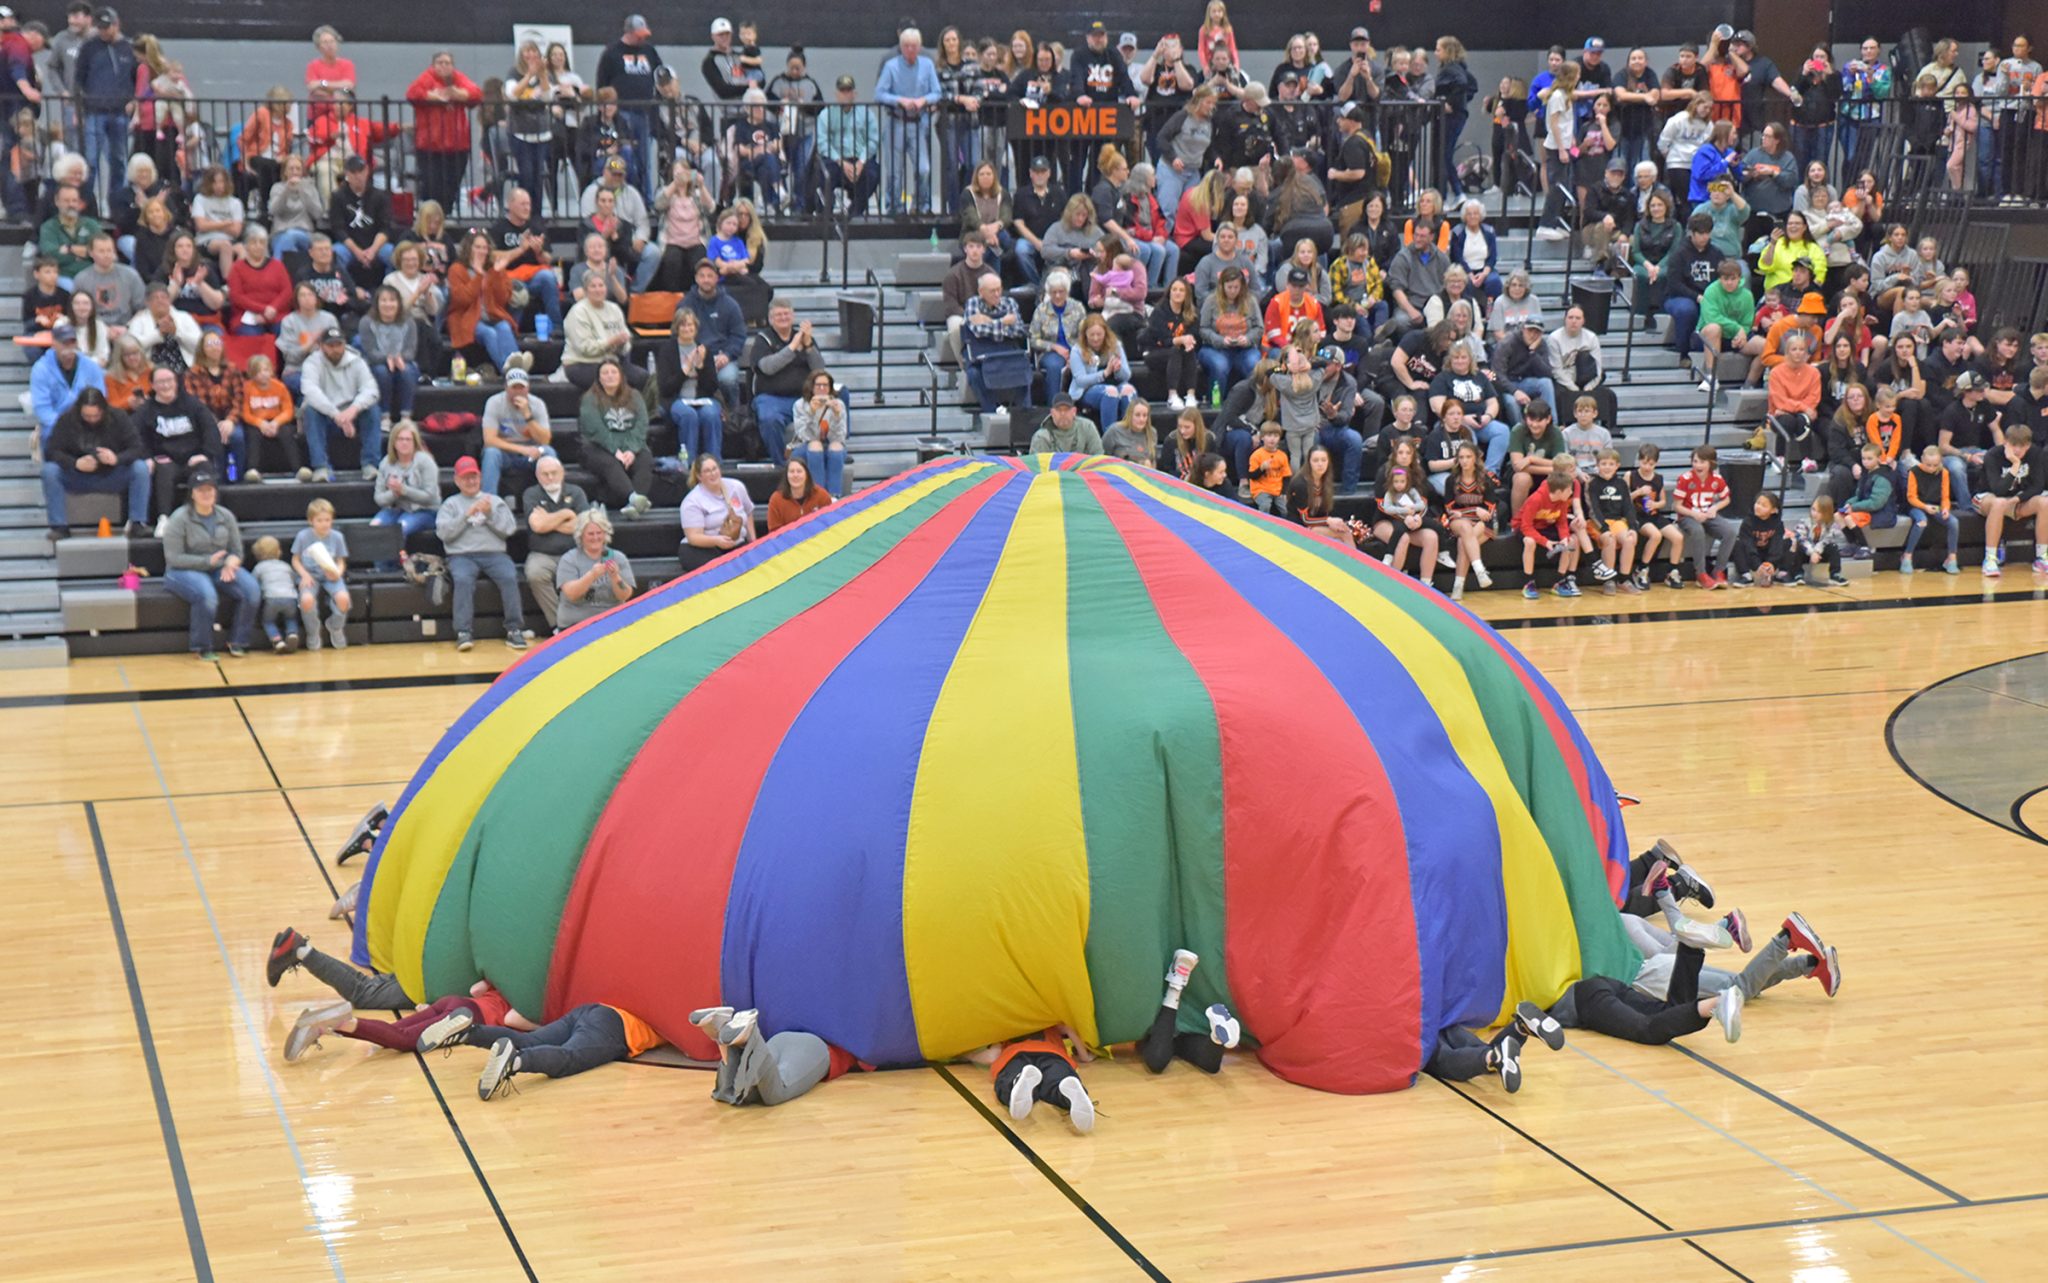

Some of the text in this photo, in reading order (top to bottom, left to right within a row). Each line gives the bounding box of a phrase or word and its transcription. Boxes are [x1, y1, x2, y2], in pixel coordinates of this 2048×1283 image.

[1087, 64, 1113, 82] XC
[1026, 108, 1117, 136] HOME
[1691, 492, 1714, 513] 15
